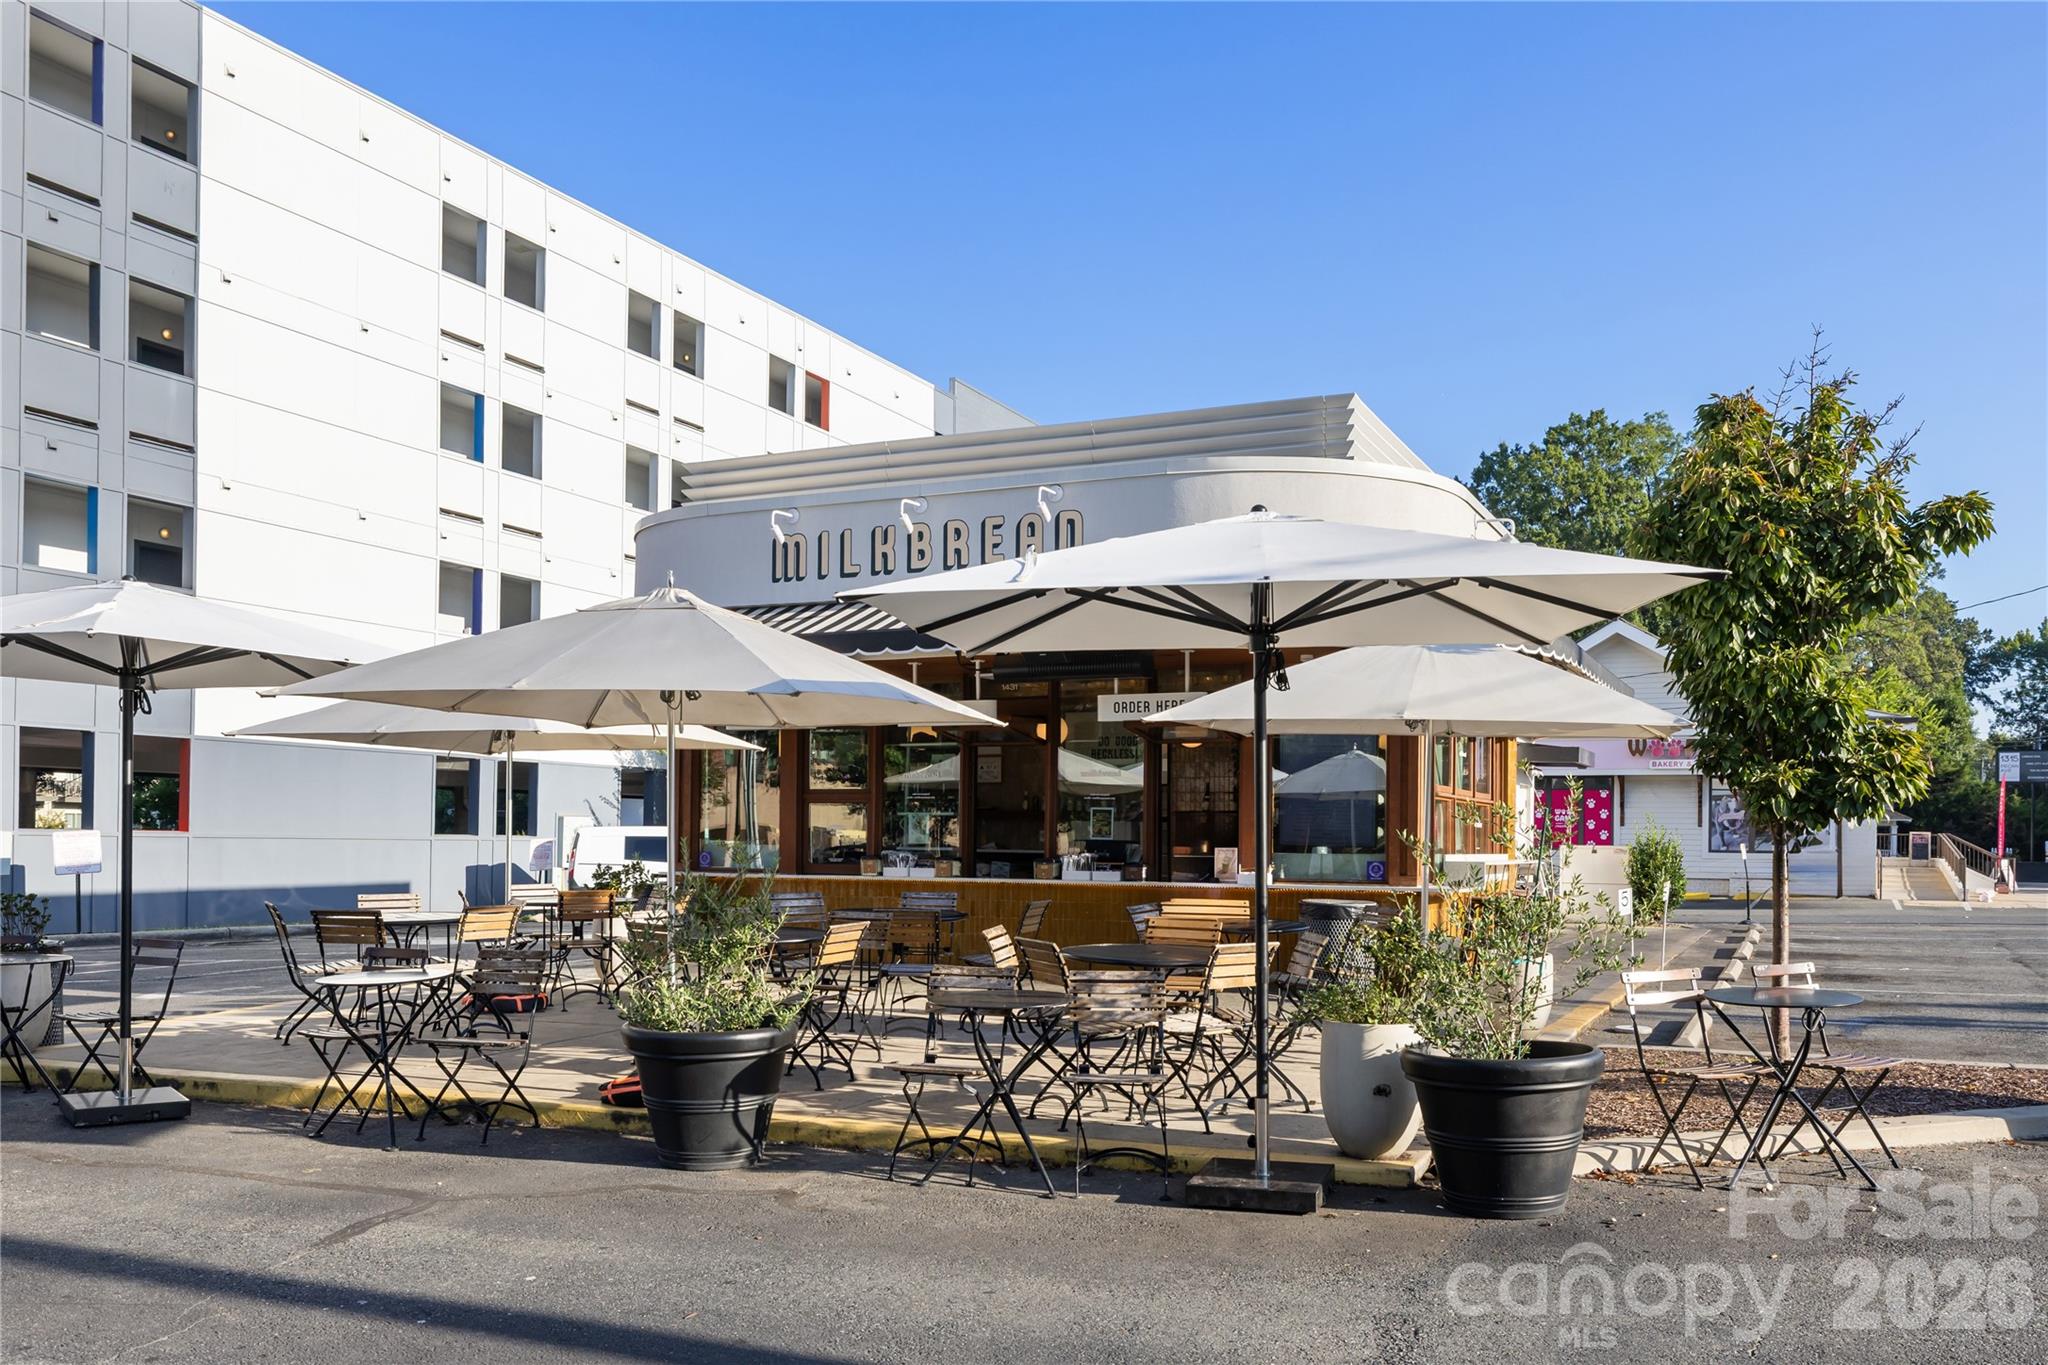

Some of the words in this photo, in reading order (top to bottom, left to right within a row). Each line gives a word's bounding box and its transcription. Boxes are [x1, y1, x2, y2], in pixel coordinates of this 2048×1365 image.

[772, 509, 1085, 584] MILKBREAD
[1113, 701, 1150, 713] ORDER
[1652, 760, 1684, 768] BAKERY
[1621, 890, 1629, 907] 5
